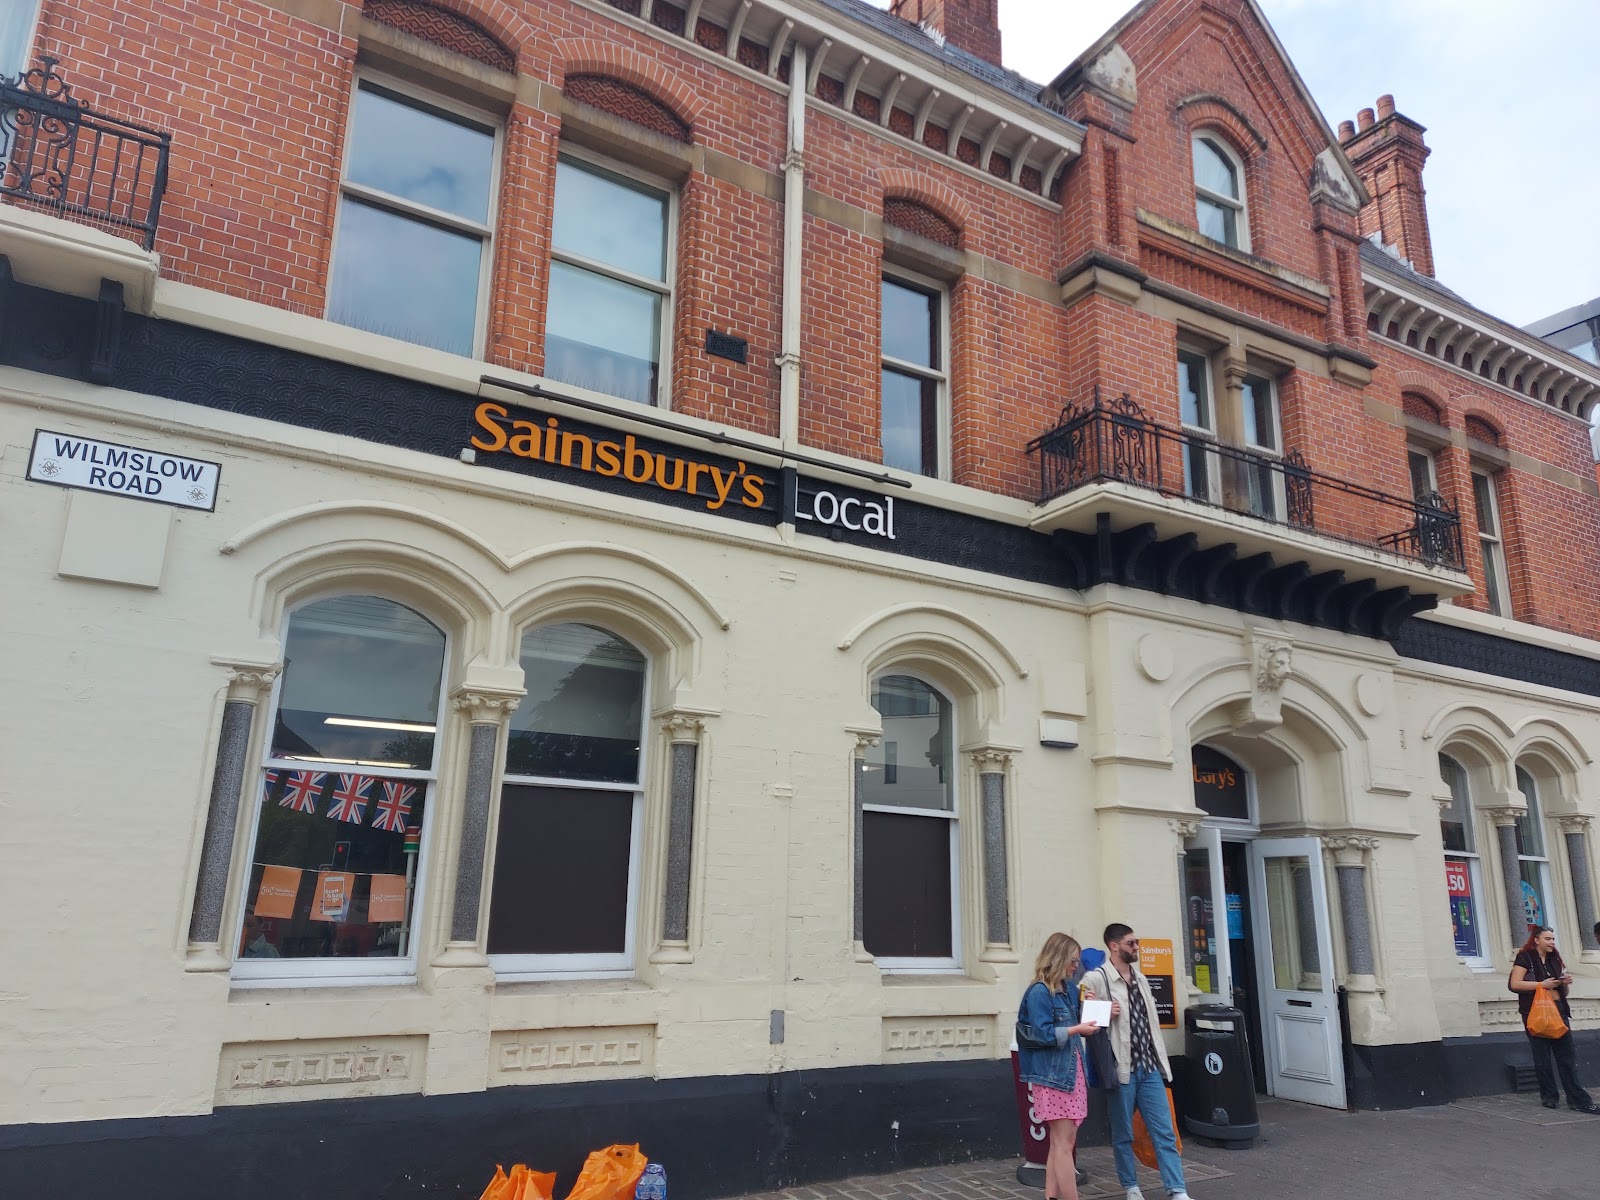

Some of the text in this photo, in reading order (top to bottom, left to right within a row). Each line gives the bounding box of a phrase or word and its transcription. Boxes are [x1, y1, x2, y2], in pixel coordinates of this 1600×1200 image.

[54, 438, 204, 482] WILMSLOW
[470, 402, 896, 540] Sainsbury's Local
[89, 466, 162, 496] ROAD
[1141, 946, 1172, 956] Sainsbury's
[1141, 955, 1156, 963] Local
